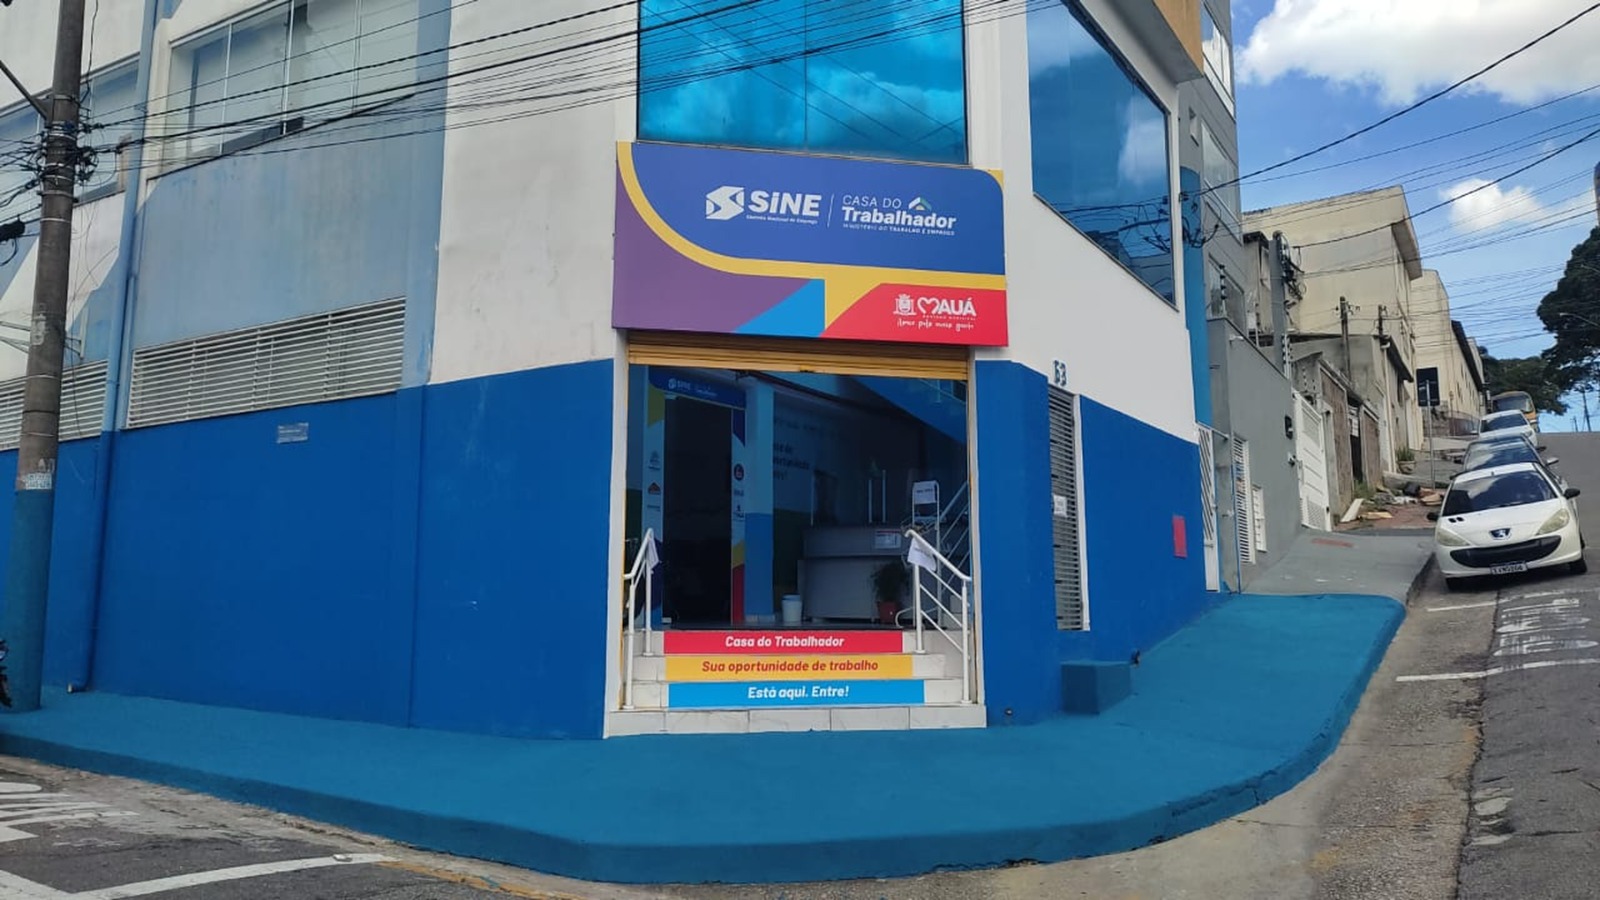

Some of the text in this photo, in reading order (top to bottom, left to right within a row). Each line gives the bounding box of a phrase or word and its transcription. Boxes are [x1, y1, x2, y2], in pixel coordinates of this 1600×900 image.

[842, 195, 902, 209] CASA DO
[842, 206, 957, 229] Trabalhador
[725, 636, 845, 647] Casa do Trabalhador
[702, 660, 879, 674] Sua oportunidade de trabalho
[748, 686, 849, 700] Está aqui. Entre!
